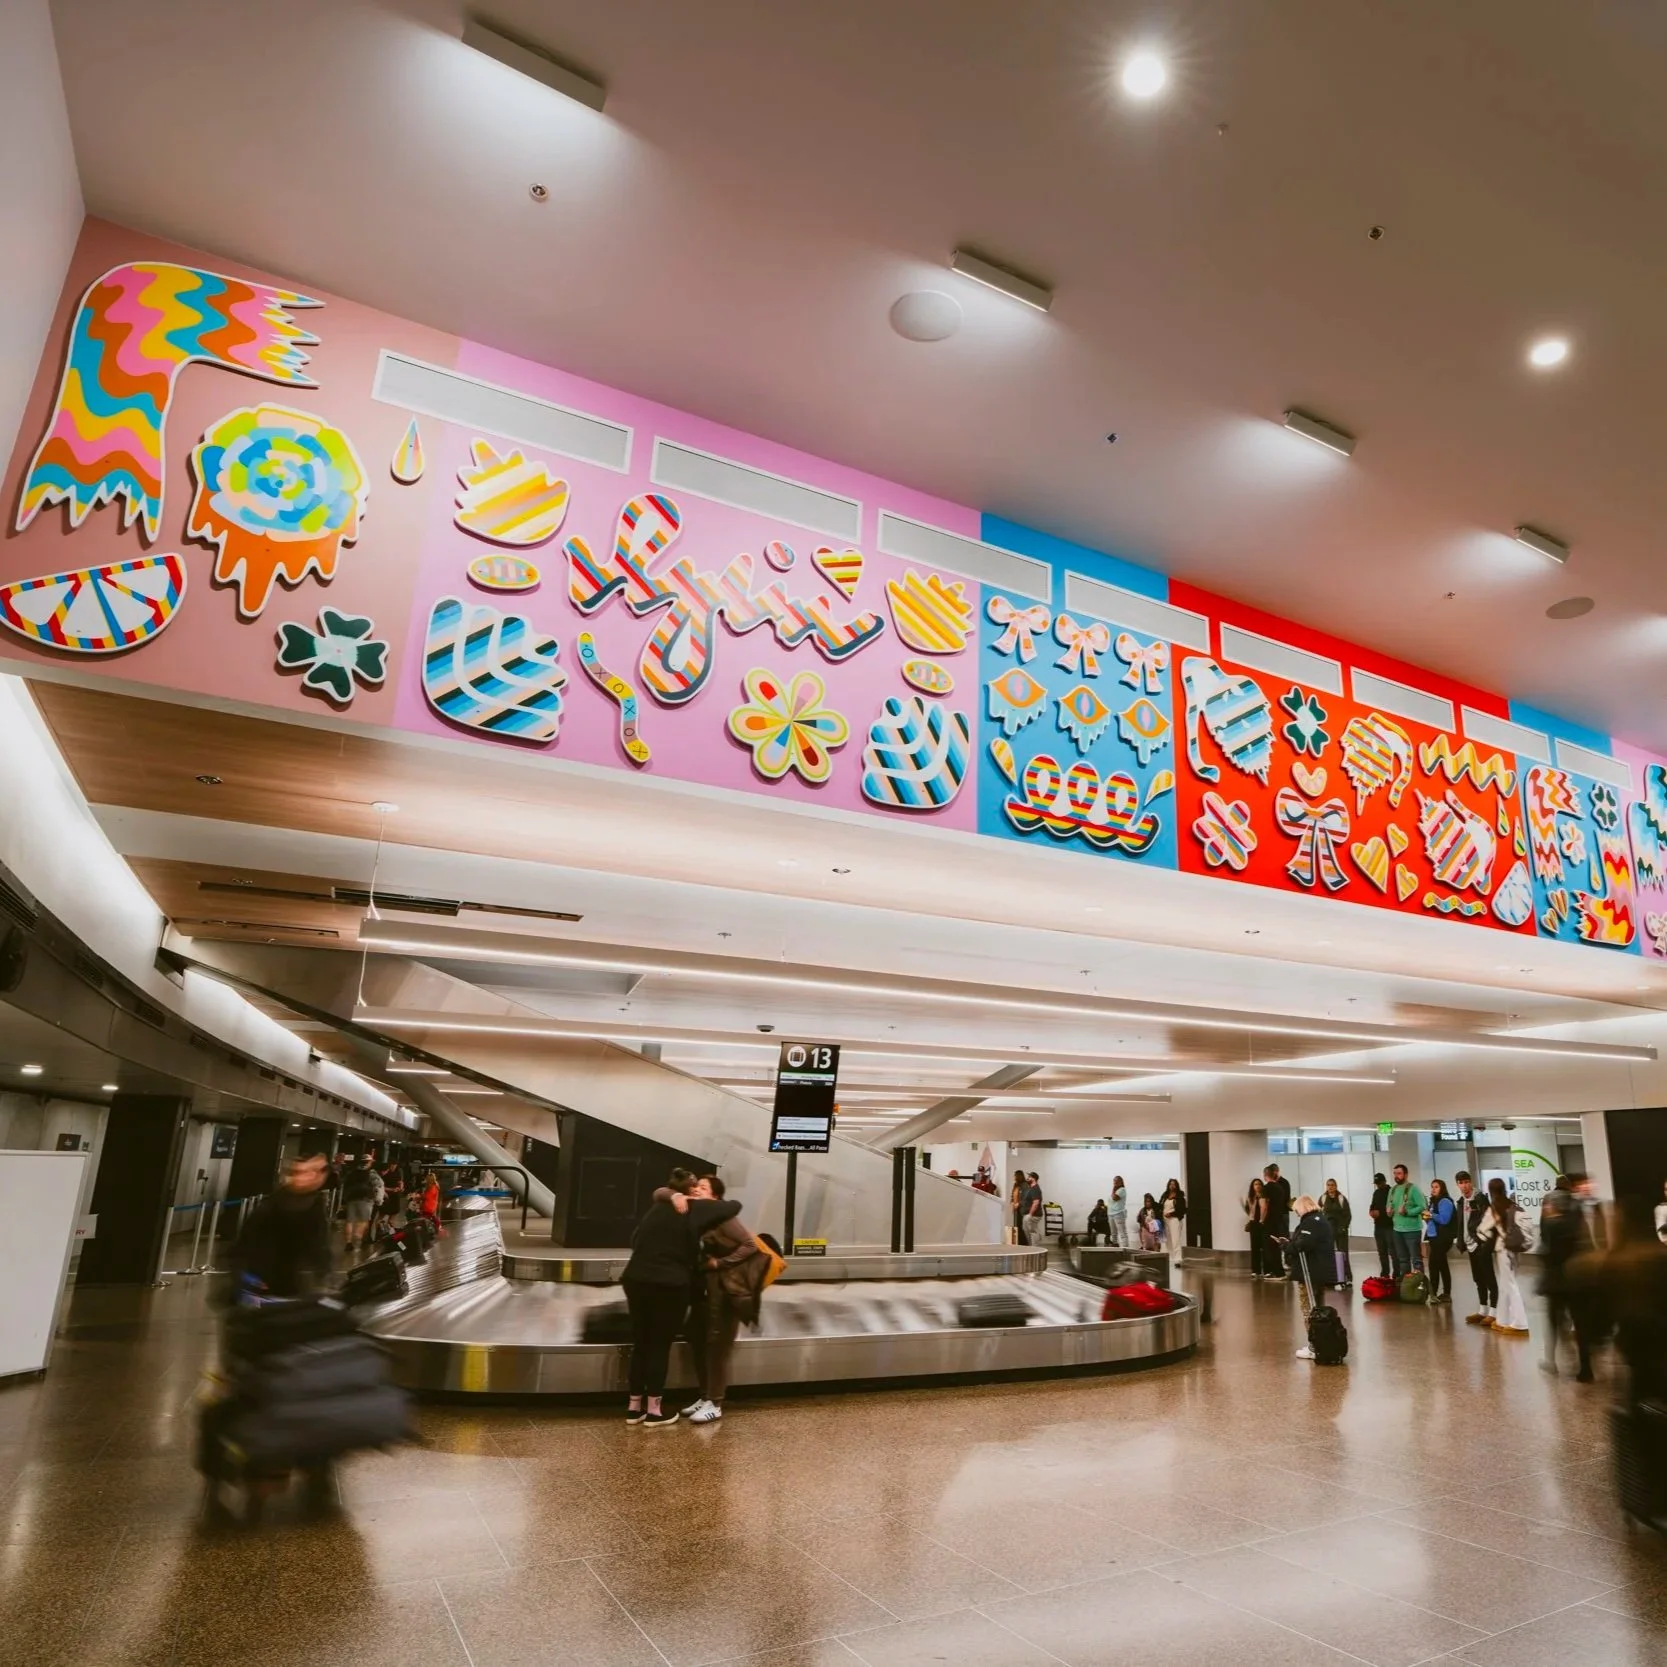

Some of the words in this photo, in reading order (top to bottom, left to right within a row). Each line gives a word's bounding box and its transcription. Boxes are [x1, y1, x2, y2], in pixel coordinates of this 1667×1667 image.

[811, 1047, 832, 1069] 13
[1514, 1160, 1535, 1168] SEA
[1516, 1179, 1541, 1191] Lost
[1543, 1179, 1551, 1192] &
